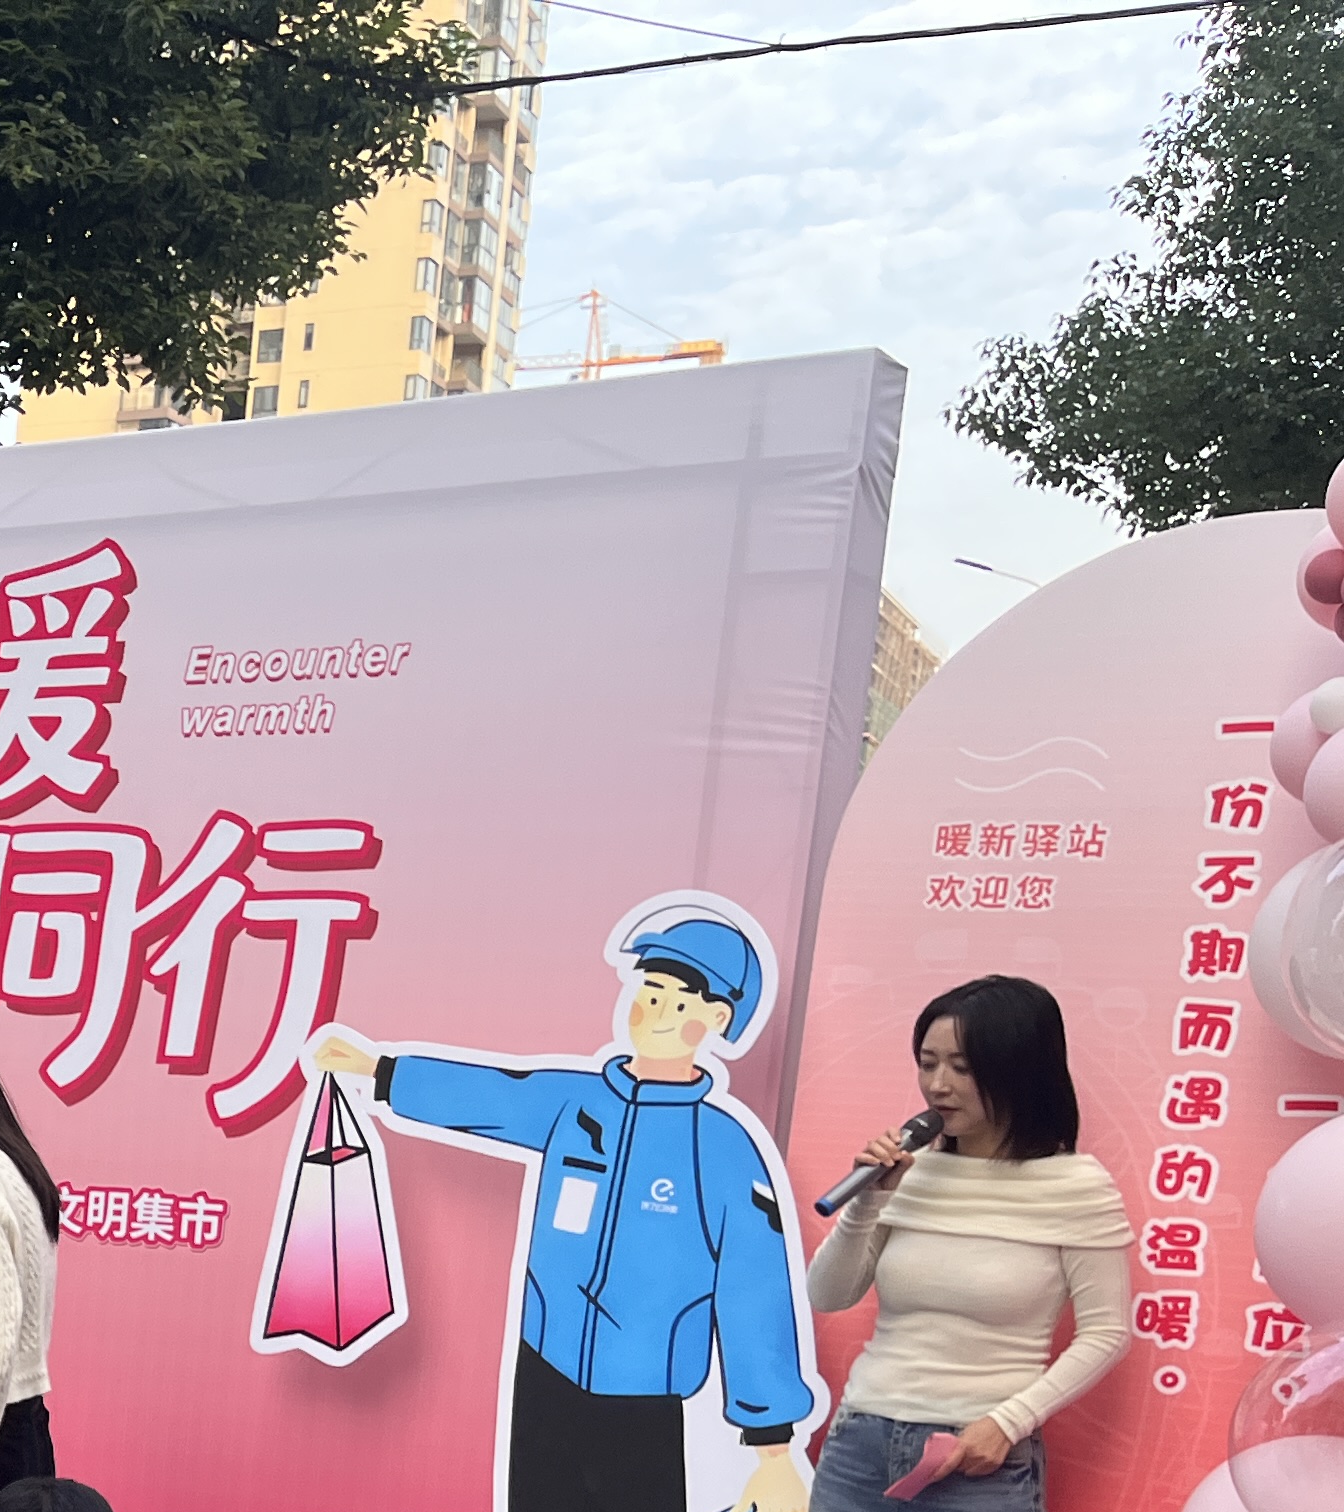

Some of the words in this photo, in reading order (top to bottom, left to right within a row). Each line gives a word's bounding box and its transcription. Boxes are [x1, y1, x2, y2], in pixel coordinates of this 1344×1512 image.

[184, 638, 411, 685] Encounter
[179, 694, 335, 738] warmth
[934, 822, 1107, 858] 暖新驿站
[925, 874, 1054, 909] 欢迎您
